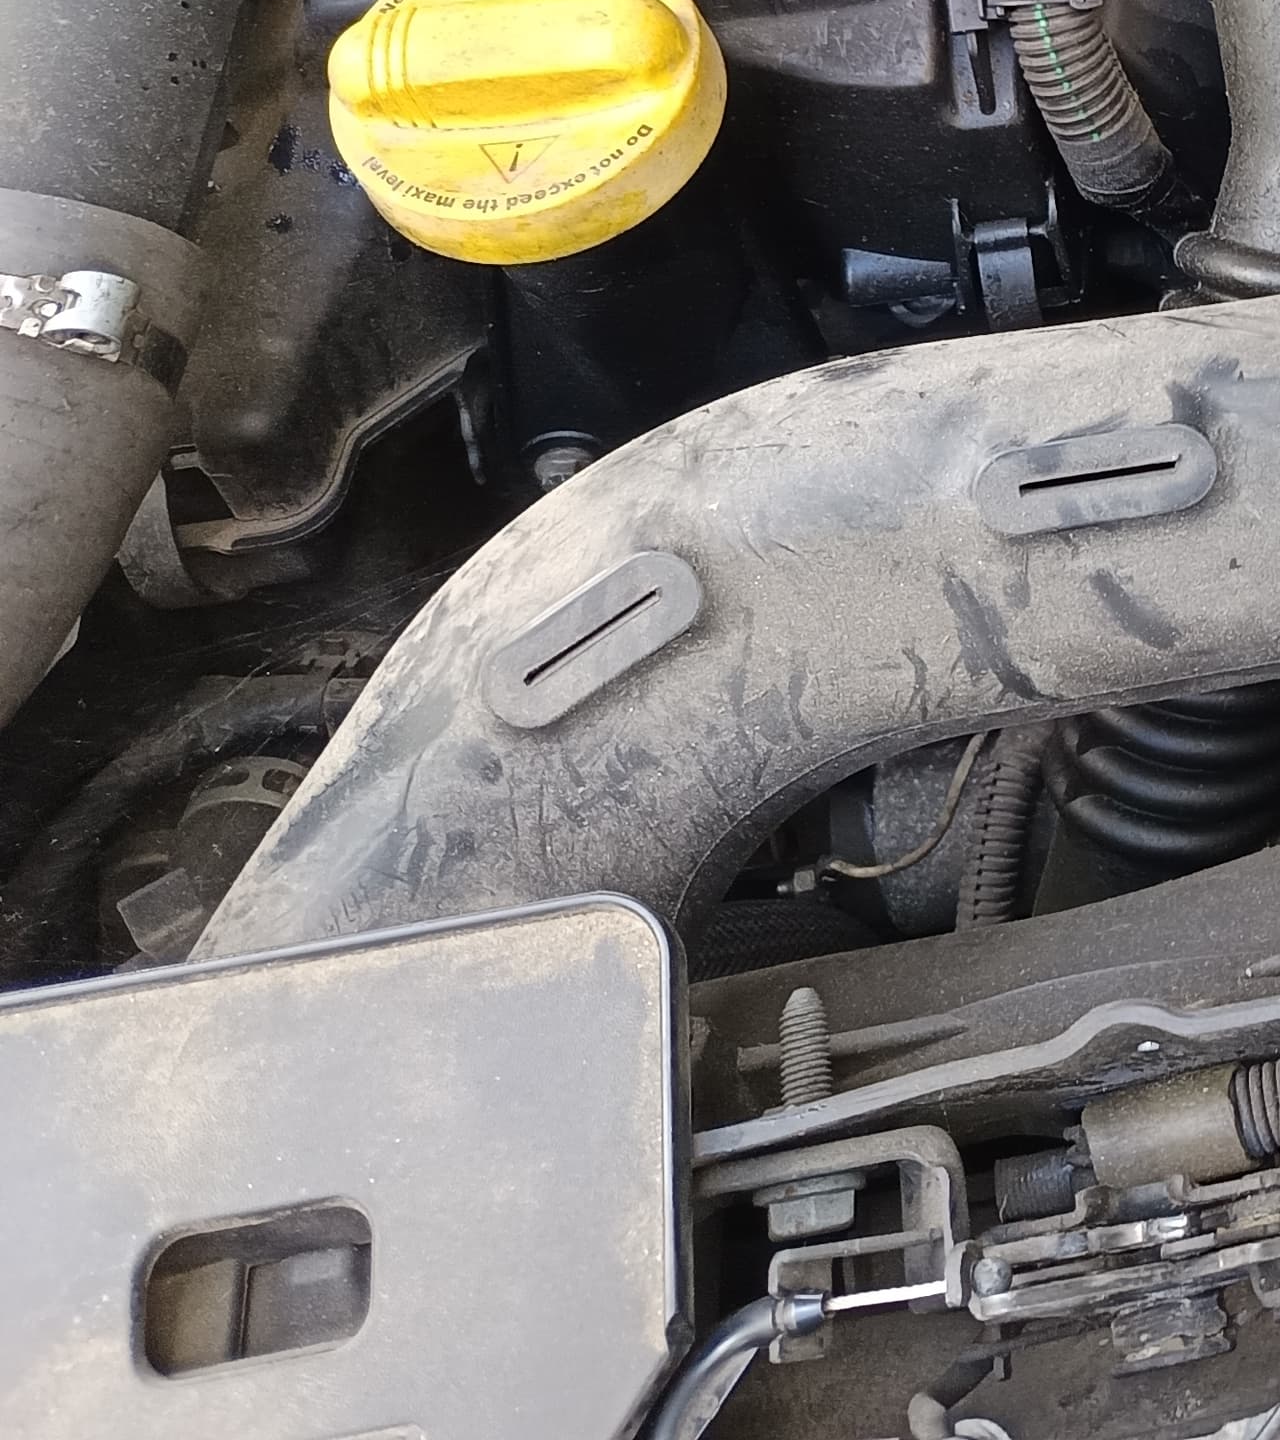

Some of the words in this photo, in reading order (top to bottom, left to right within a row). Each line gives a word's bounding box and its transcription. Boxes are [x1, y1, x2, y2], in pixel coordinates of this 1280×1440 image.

[626, 123, 654, 146] Do
[361, 156, 401, 191] level
[590, 149, 625, 177] not
[401, 187, 456, 208] maxi
[505, 173, 586, 210] exceed
[462, 198, 499, 213] the
